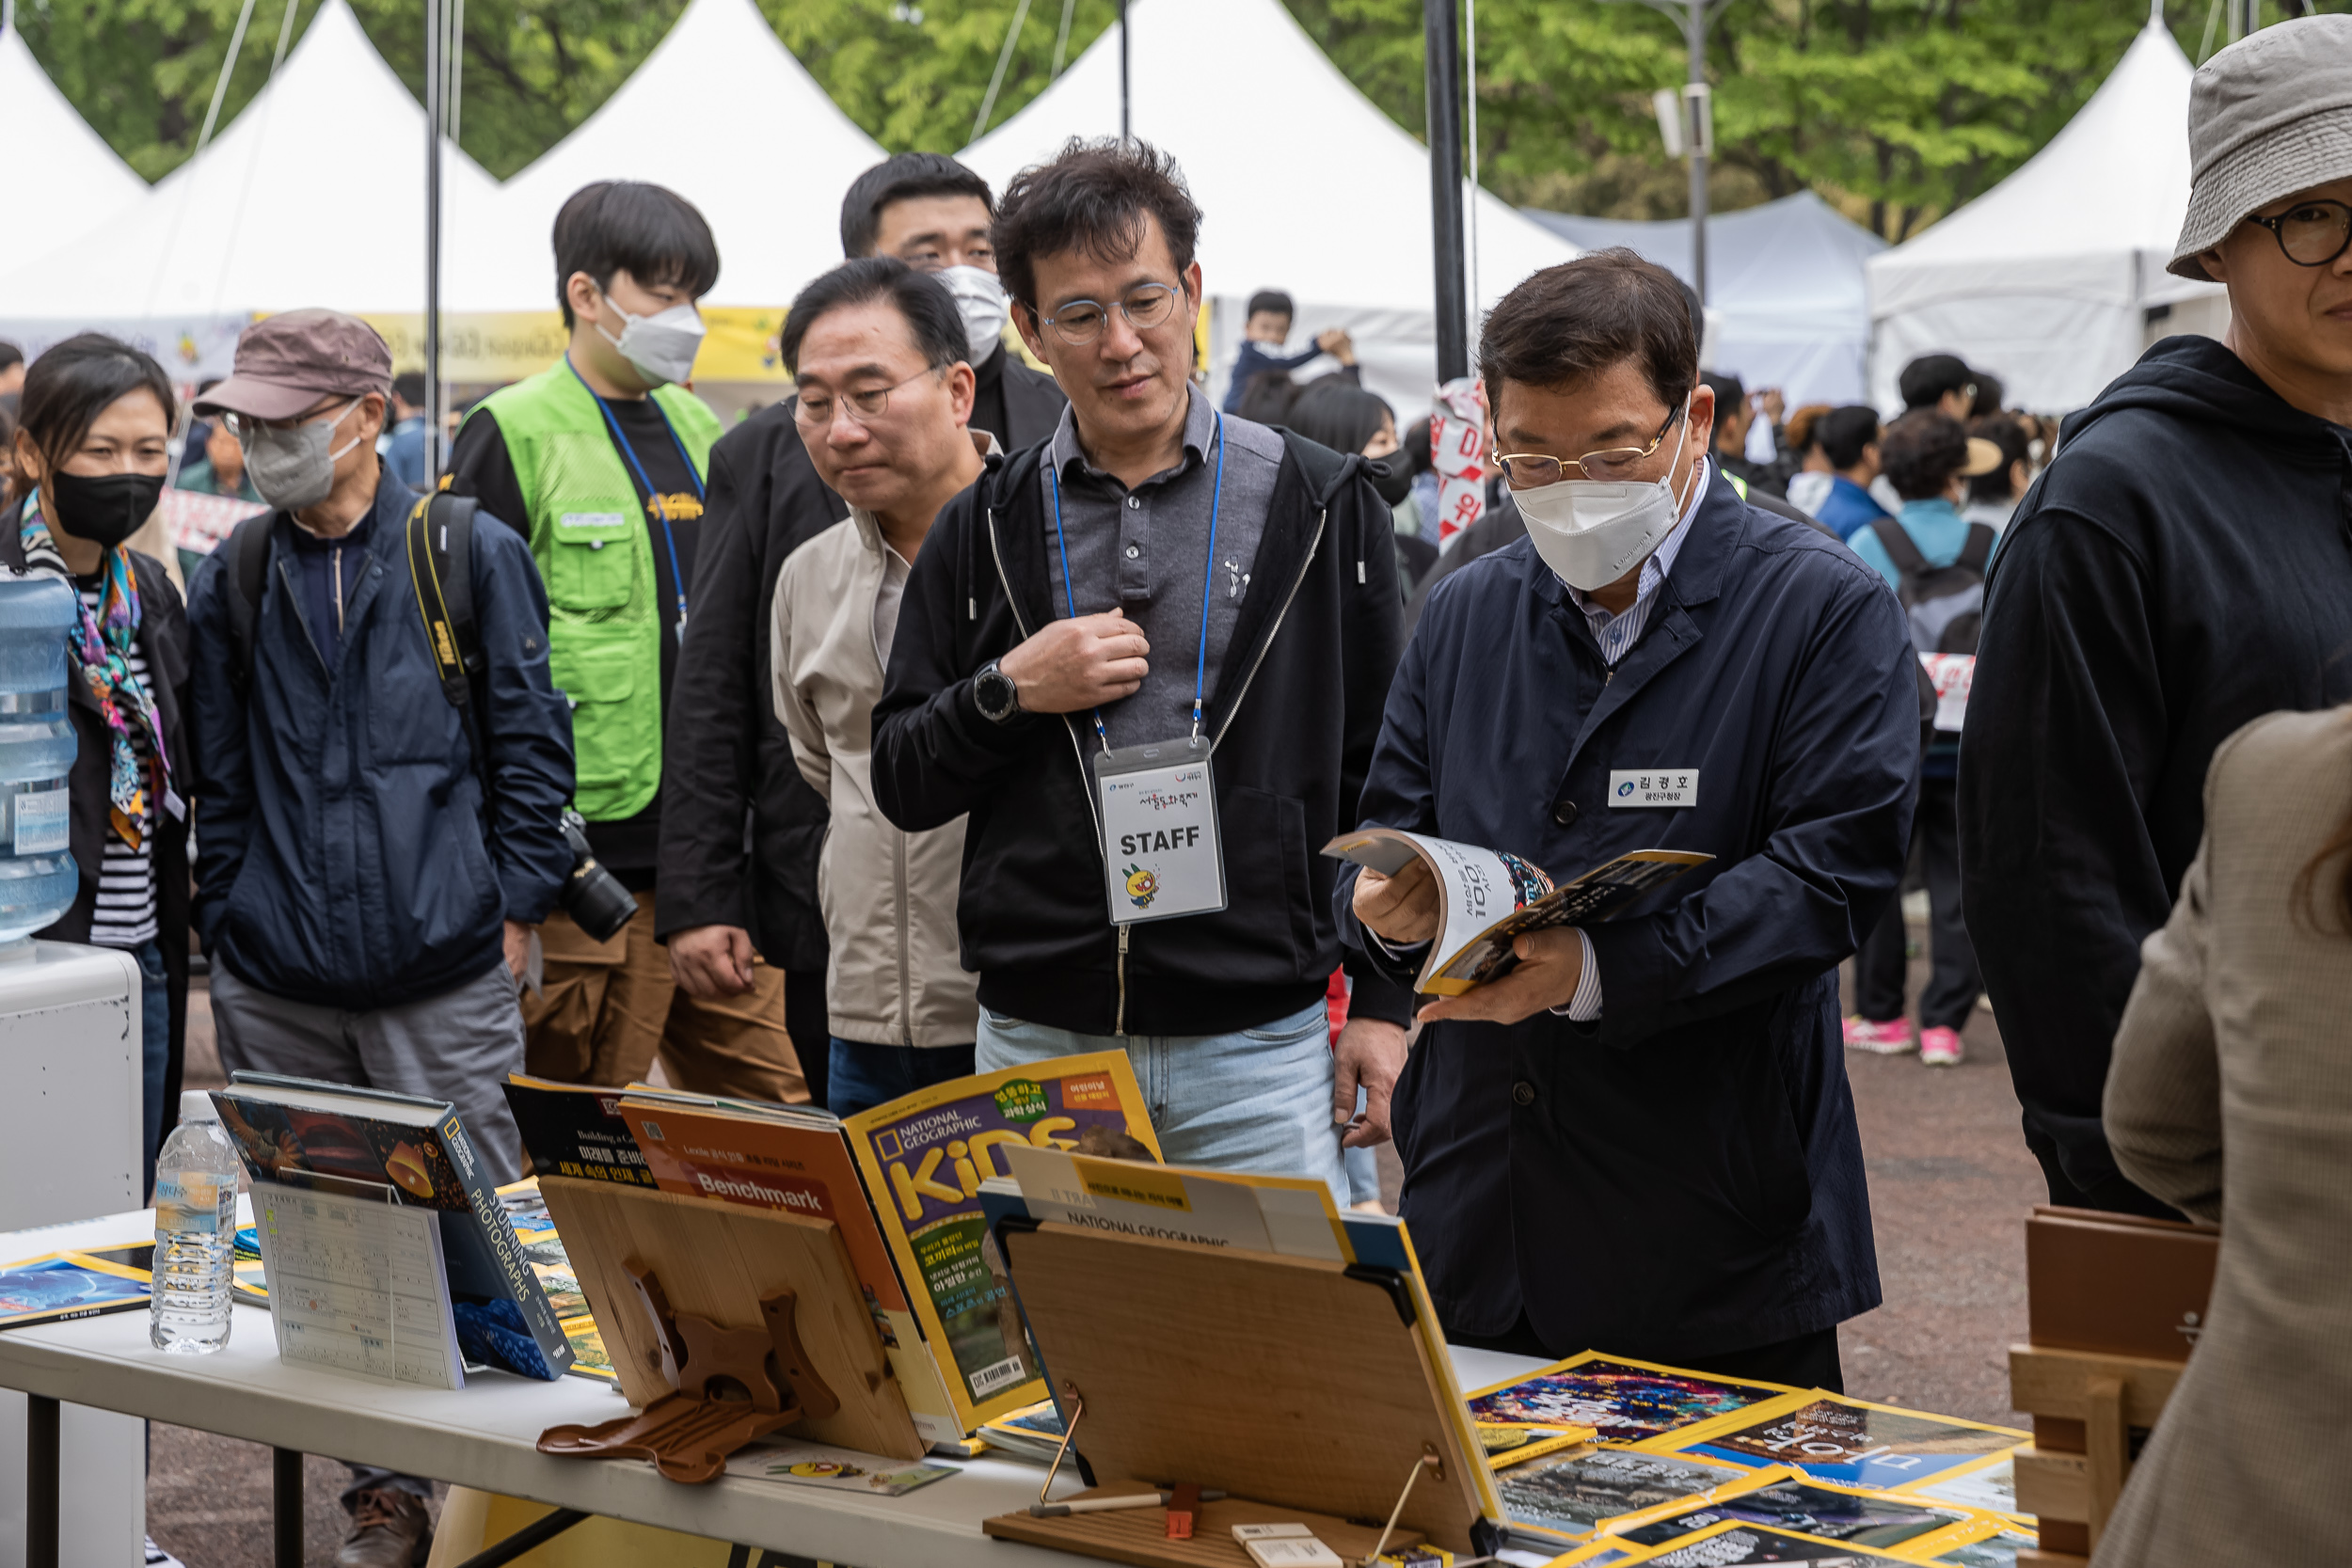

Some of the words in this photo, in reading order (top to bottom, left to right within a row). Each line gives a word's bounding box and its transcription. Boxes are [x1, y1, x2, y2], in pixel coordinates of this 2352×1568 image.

[1645, 792, 1680, 801] 광진구청장
[1120, 825, 1200, 856] STAFF
[1070, 1081, 1104, 1093] 어린이날
[578, 1130, 616, 1145] Building
[899, 1110, 961, 1138] NATIONAL
[903, 1117, 982, 1150] GEOGRAPHIC
[451, 1136, 475, 1180] GEOGRAPHIC
[455, 1130, 475, 1166] NATIONAL
[560, 1162, 583, 1177] 세계
[584, 1164, 609, 1180] 속의
[697, 1173, 822, 1212] Benchmark
[488, 1193, 532, 1276] STUNNING
[1067, 1211, 1138, 1236] NATIONAL
[470, 1187, 531, 1303] PHOTOGRAPHS
